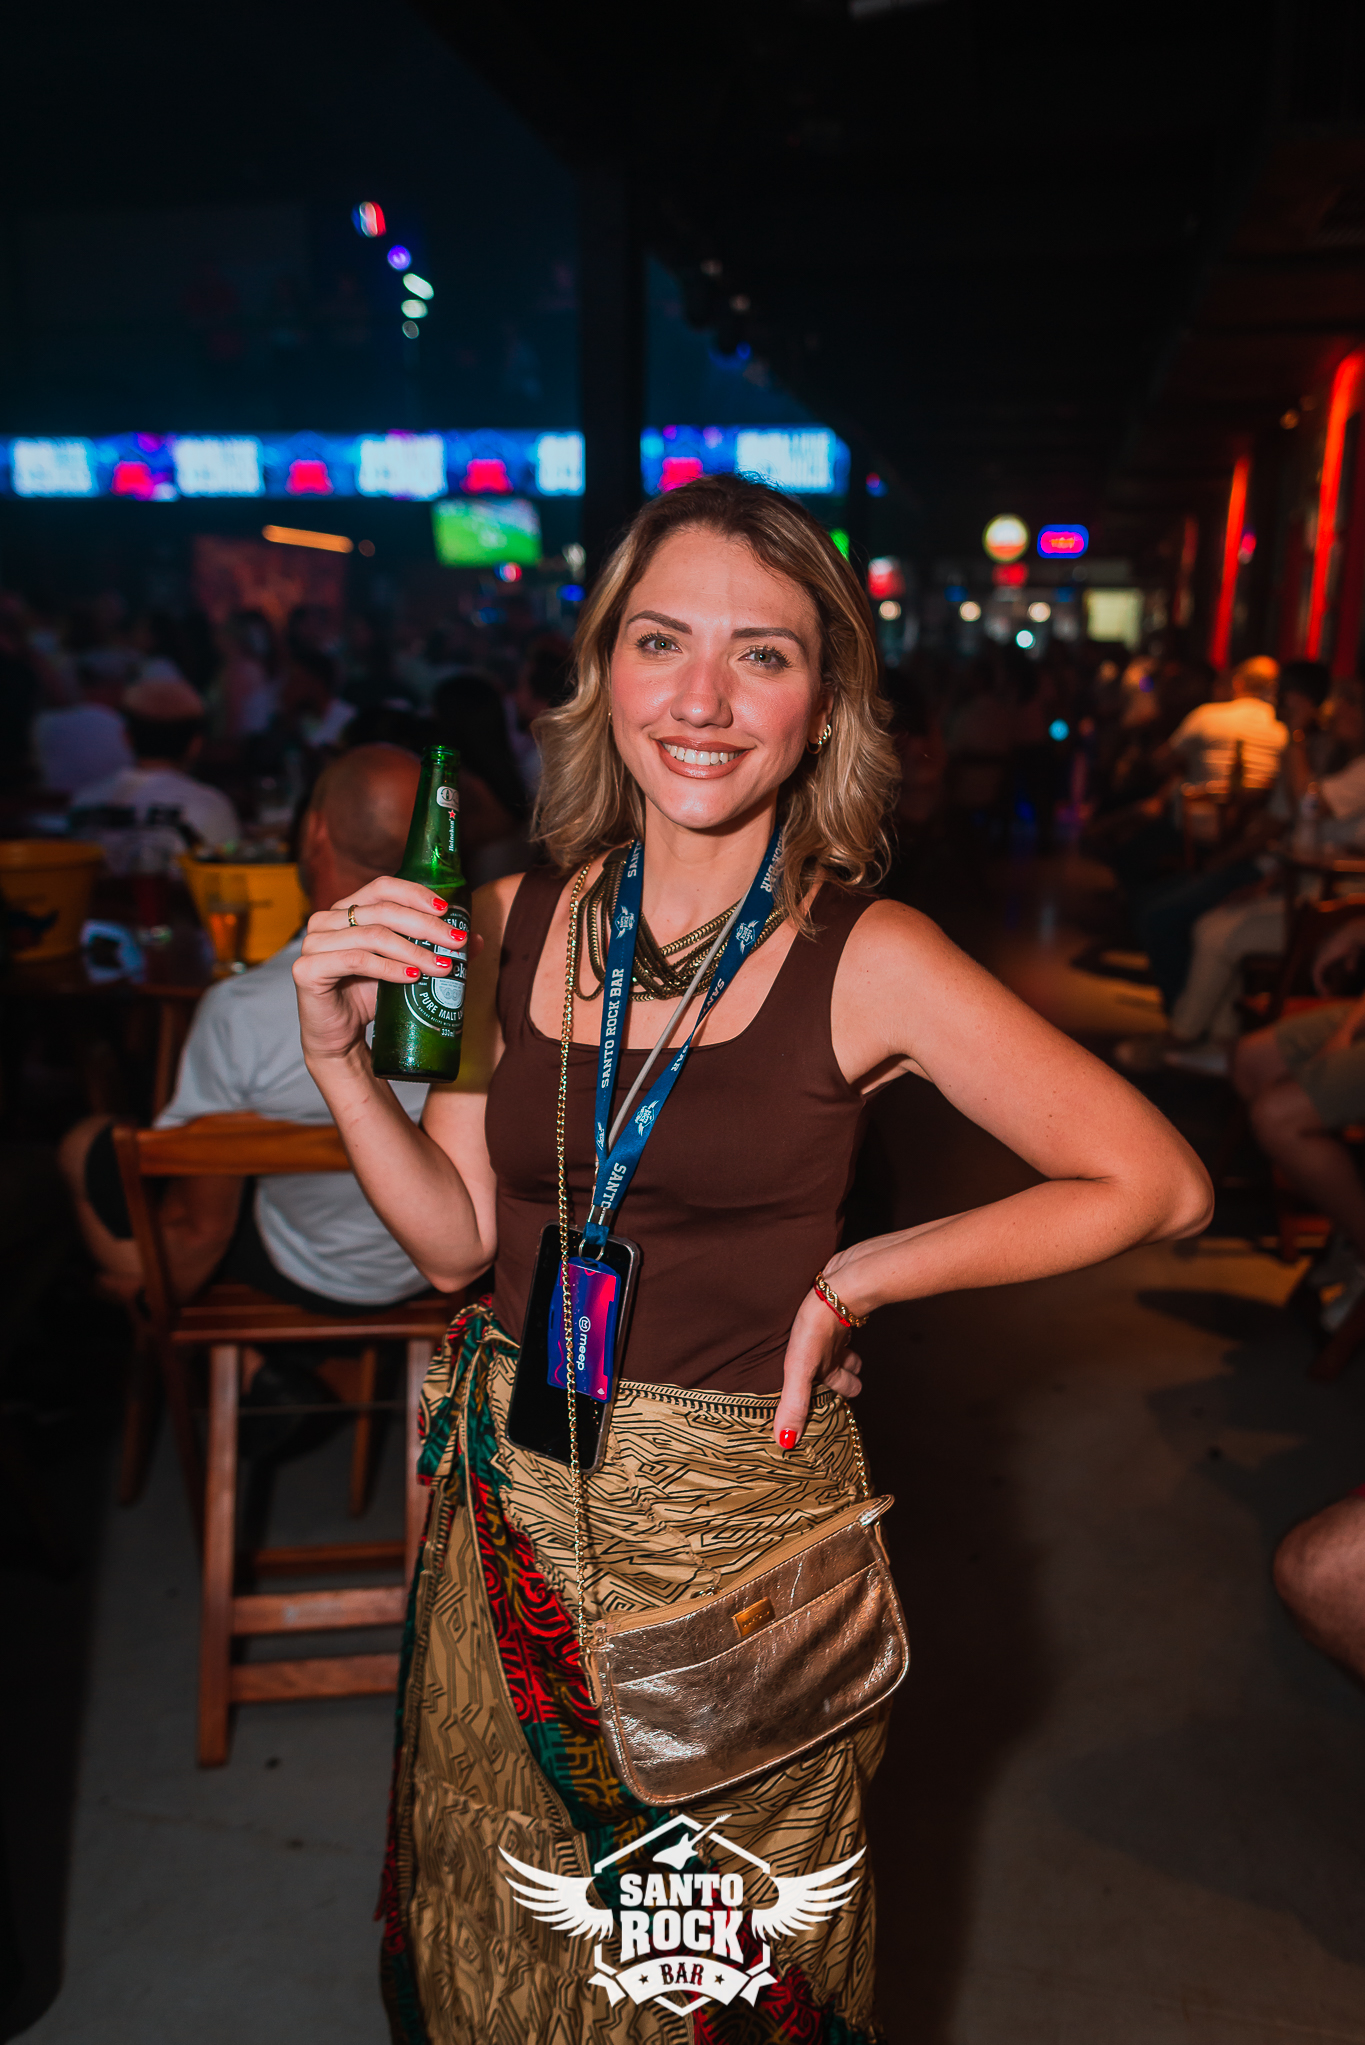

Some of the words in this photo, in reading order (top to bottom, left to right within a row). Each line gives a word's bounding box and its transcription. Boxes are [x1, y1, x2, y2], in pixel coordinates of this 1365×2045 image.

[609, 968, 625, 998] BAR
[419, 992, 439, 1014] PURE
[438, 1009, 457, 1021] MALT
[605, 1000, 620, 1037] ROCK
[601, 1039, 615, 1089] SANTO
[600, 1162, 627, 1209] SANTO
[576, 1333, 588, 1371] meep
